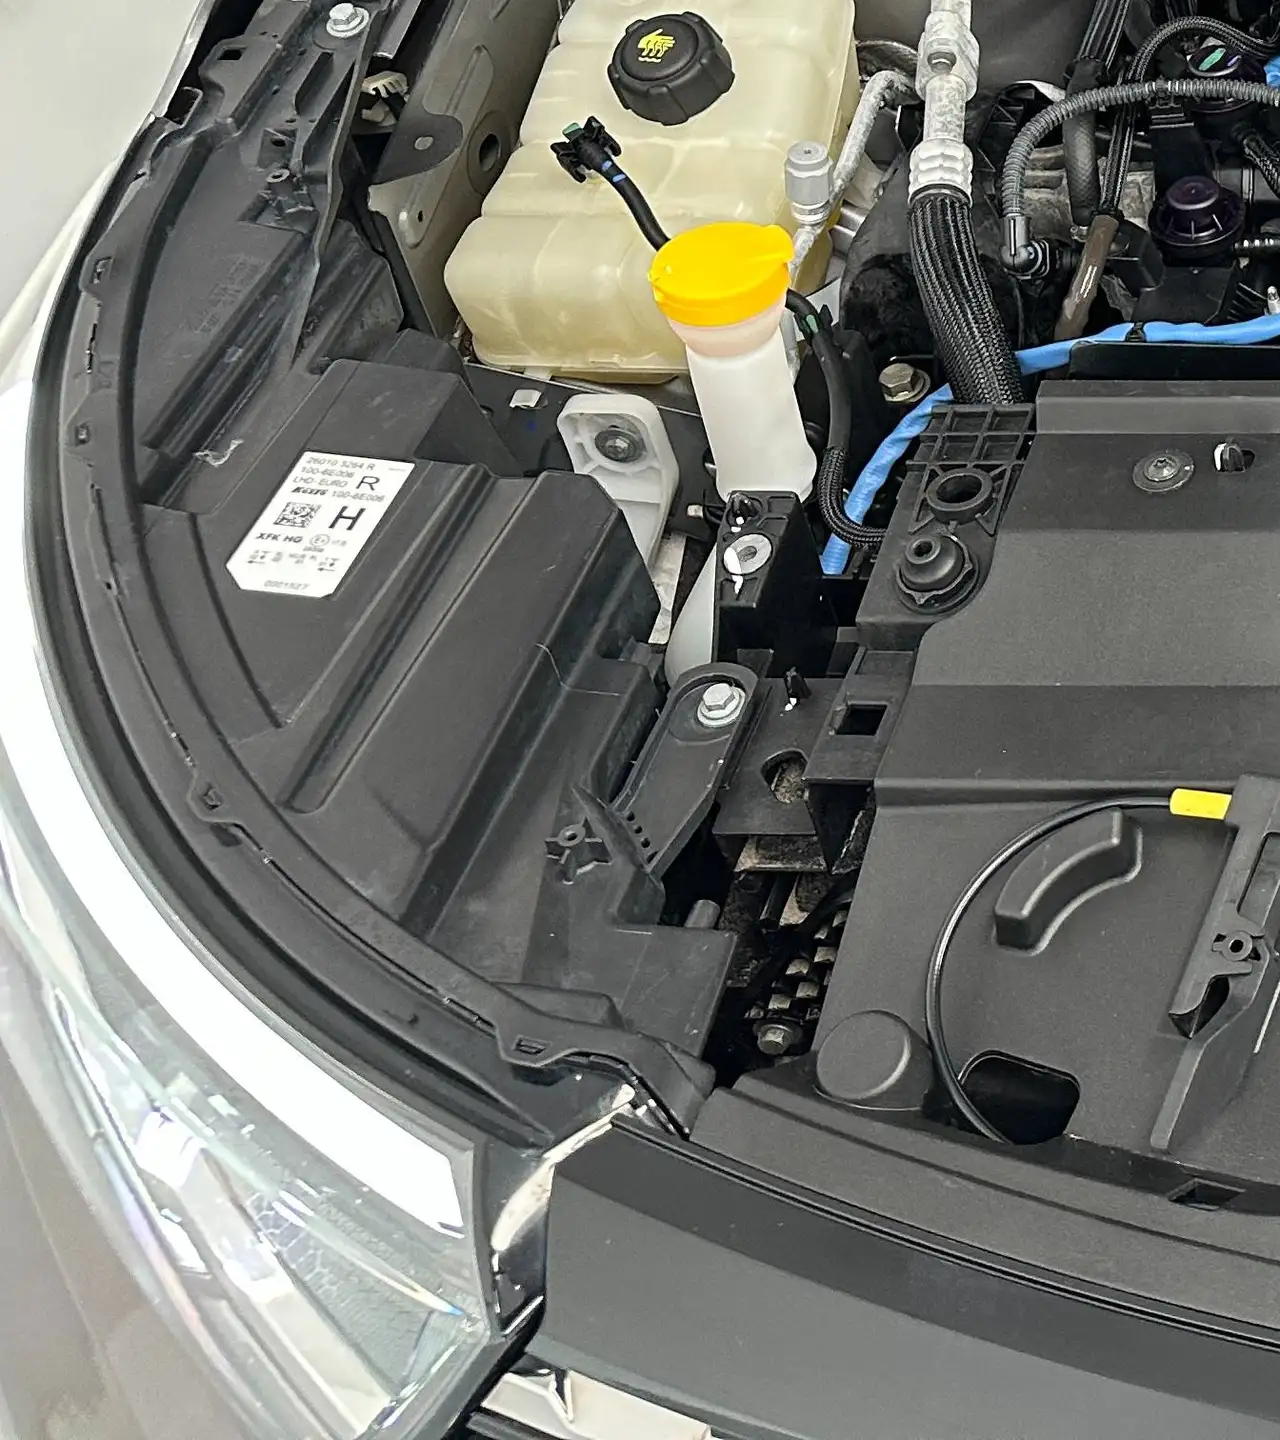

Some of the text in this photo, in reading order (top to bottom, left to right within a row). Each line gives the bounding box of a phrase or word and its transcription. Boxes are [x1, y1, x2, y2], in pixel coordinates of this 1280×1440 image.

[356, 475, 381, 492] R
[328, 505, 367, 532] H
[255, 532, 281, 542] XFK
